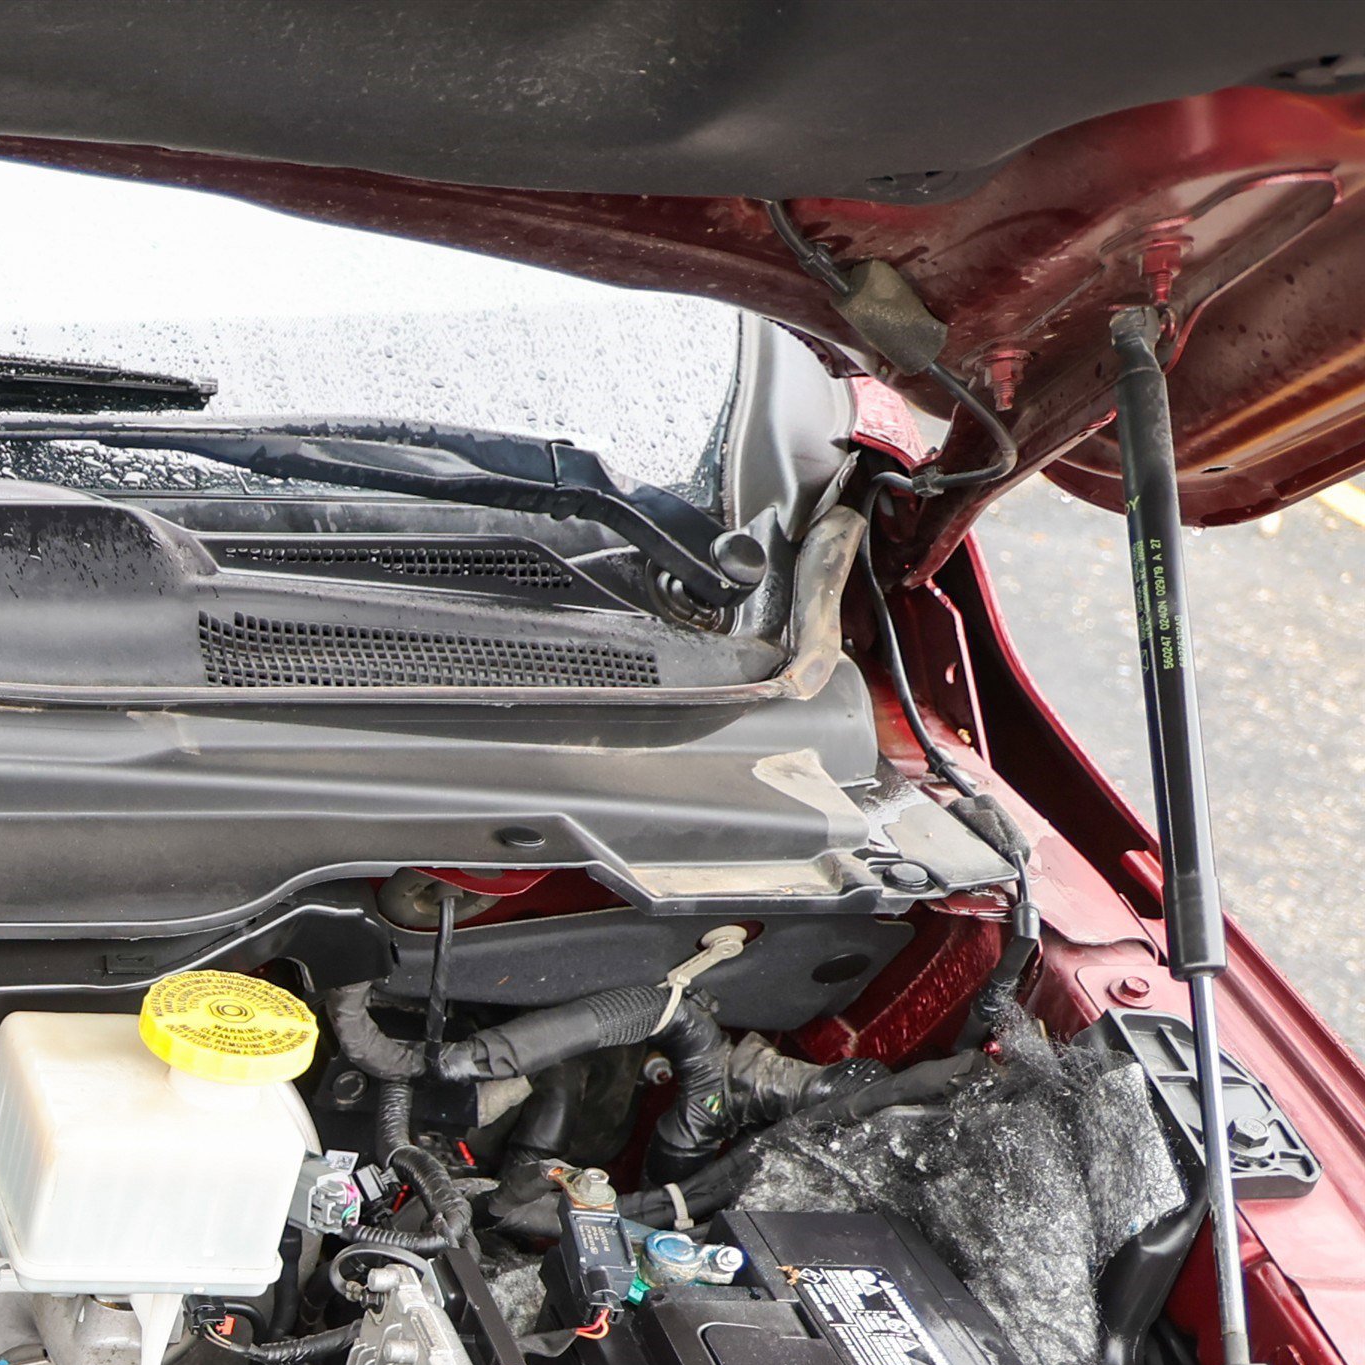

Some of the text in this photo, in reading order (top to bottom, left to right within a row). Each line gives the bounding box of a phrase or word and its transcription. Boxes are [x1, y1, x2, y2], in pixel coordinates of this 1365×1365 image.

[1149, 538, 1175, 670] 560247 0240N 029/19 A 27
[200, 1027, 231, 1040] CLEAN
[214, 1024, 262, 1034] WARNING
